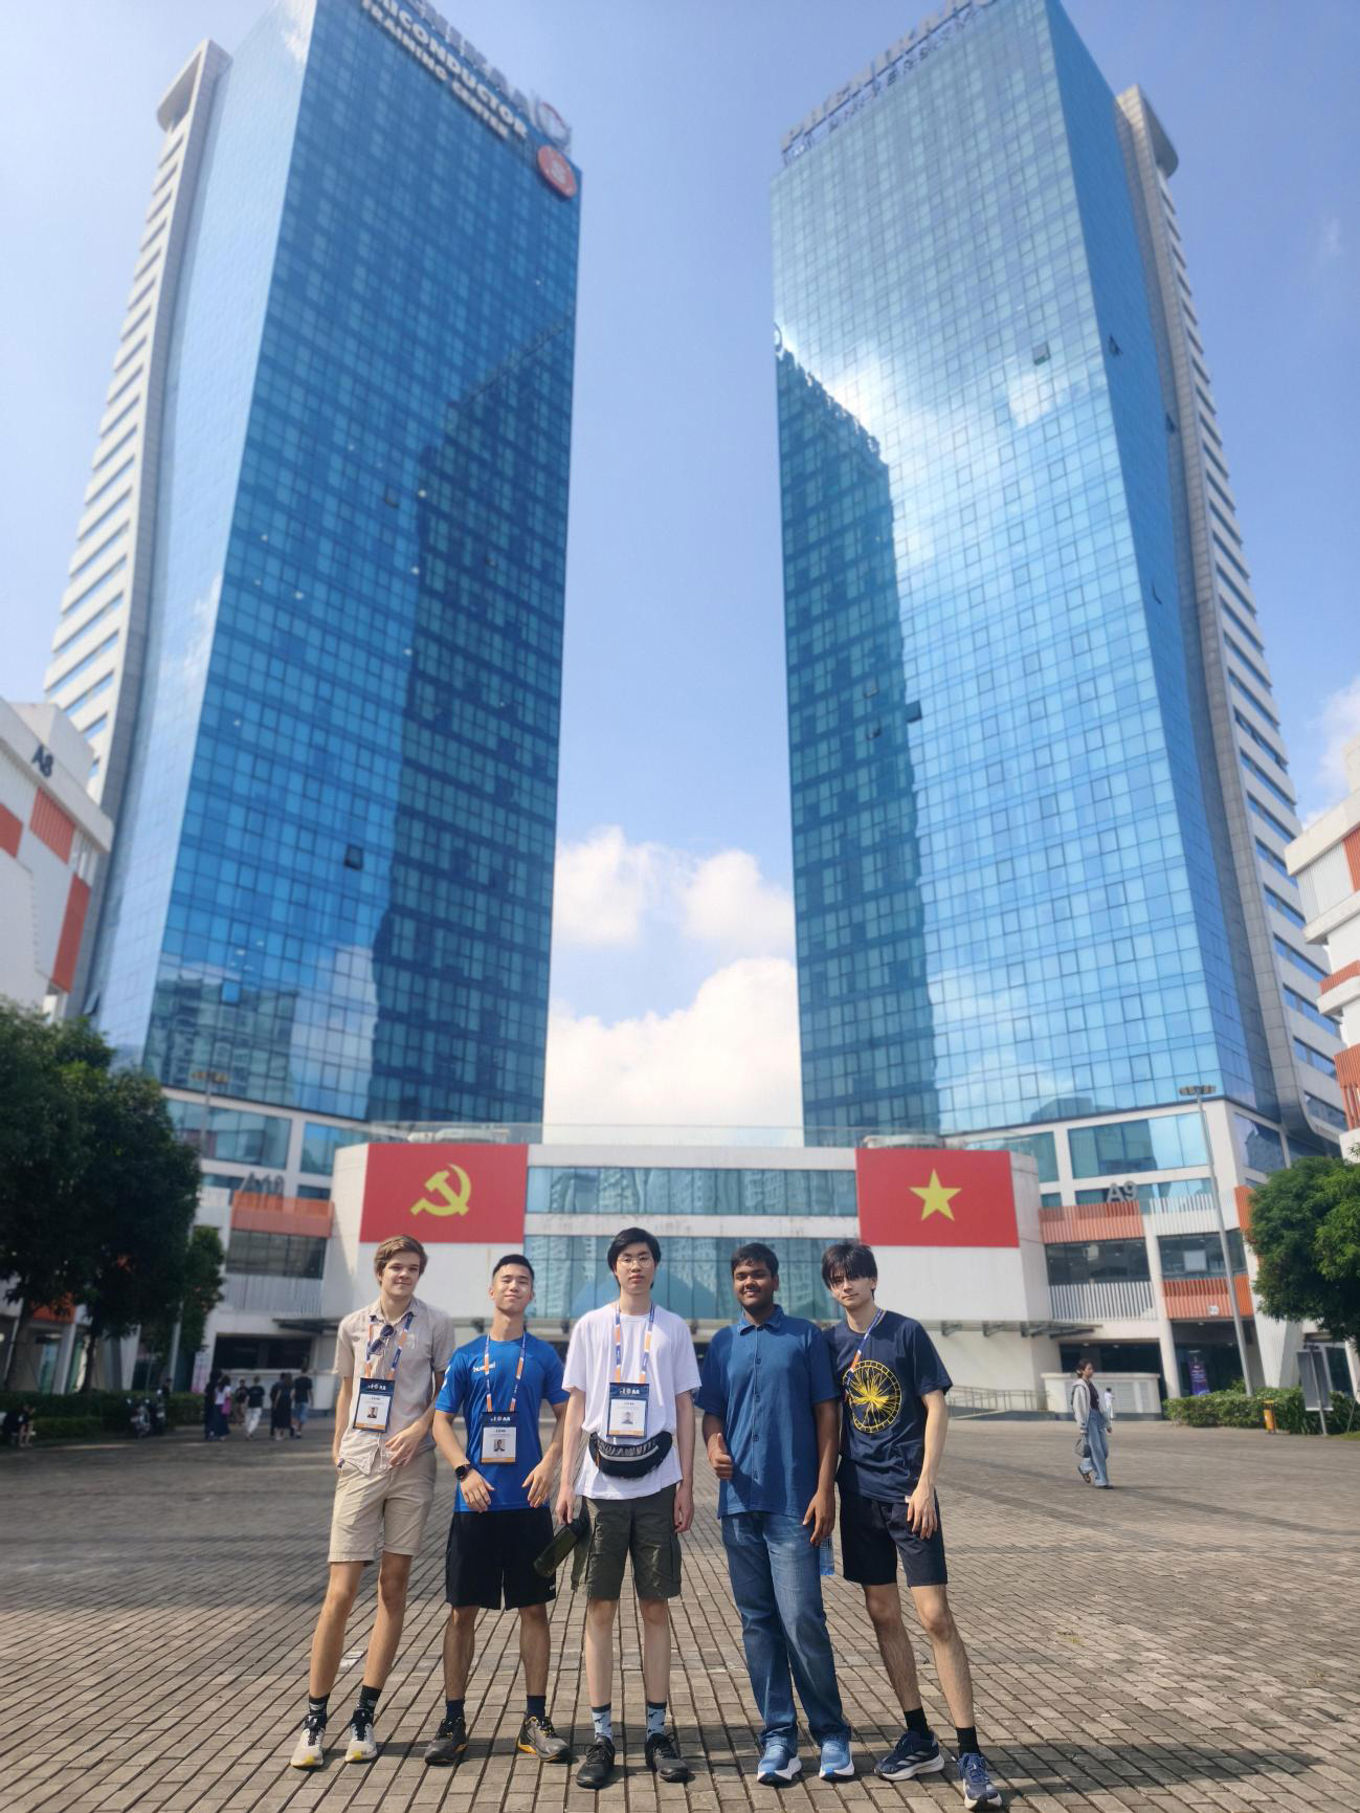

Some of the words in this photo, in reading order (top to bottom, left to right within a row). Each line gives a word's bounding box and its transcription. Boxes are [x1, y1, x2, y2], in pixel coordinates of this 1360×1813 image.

[376, 0, 526, 138] ICONDUCTOR
[31, 743, 54, 777] A8
[1106, 1180, 1138, 1203] A9
